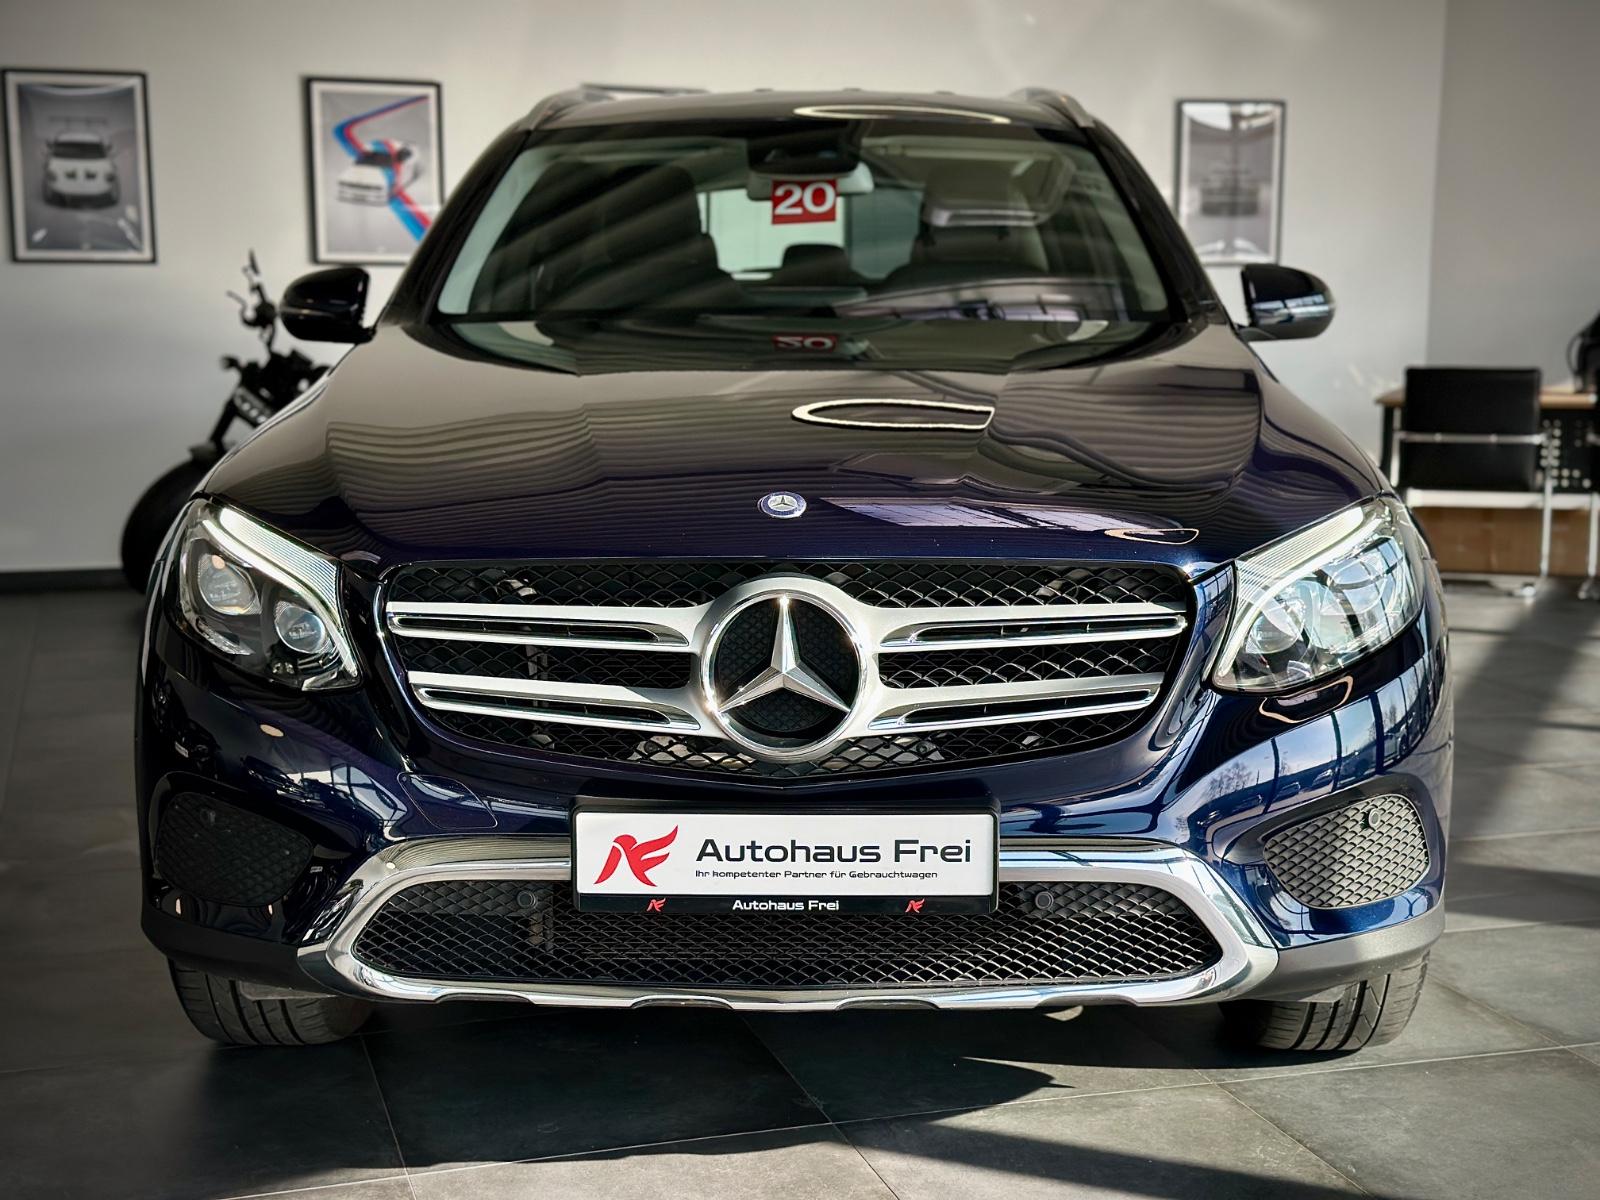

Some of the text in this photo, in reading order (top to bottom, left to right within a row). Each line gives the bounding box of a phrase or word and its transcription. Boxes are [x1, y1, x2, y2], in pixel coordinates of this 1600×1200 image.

[774, 183, 836, 215] 20
[695, 838, 971, 863] Autohaus Frei
[695, 870, 938, 880] Ihr kompetenter Partner für Gebrauchtwagen
[732, 900, 839, 911] Autohaus Frei
